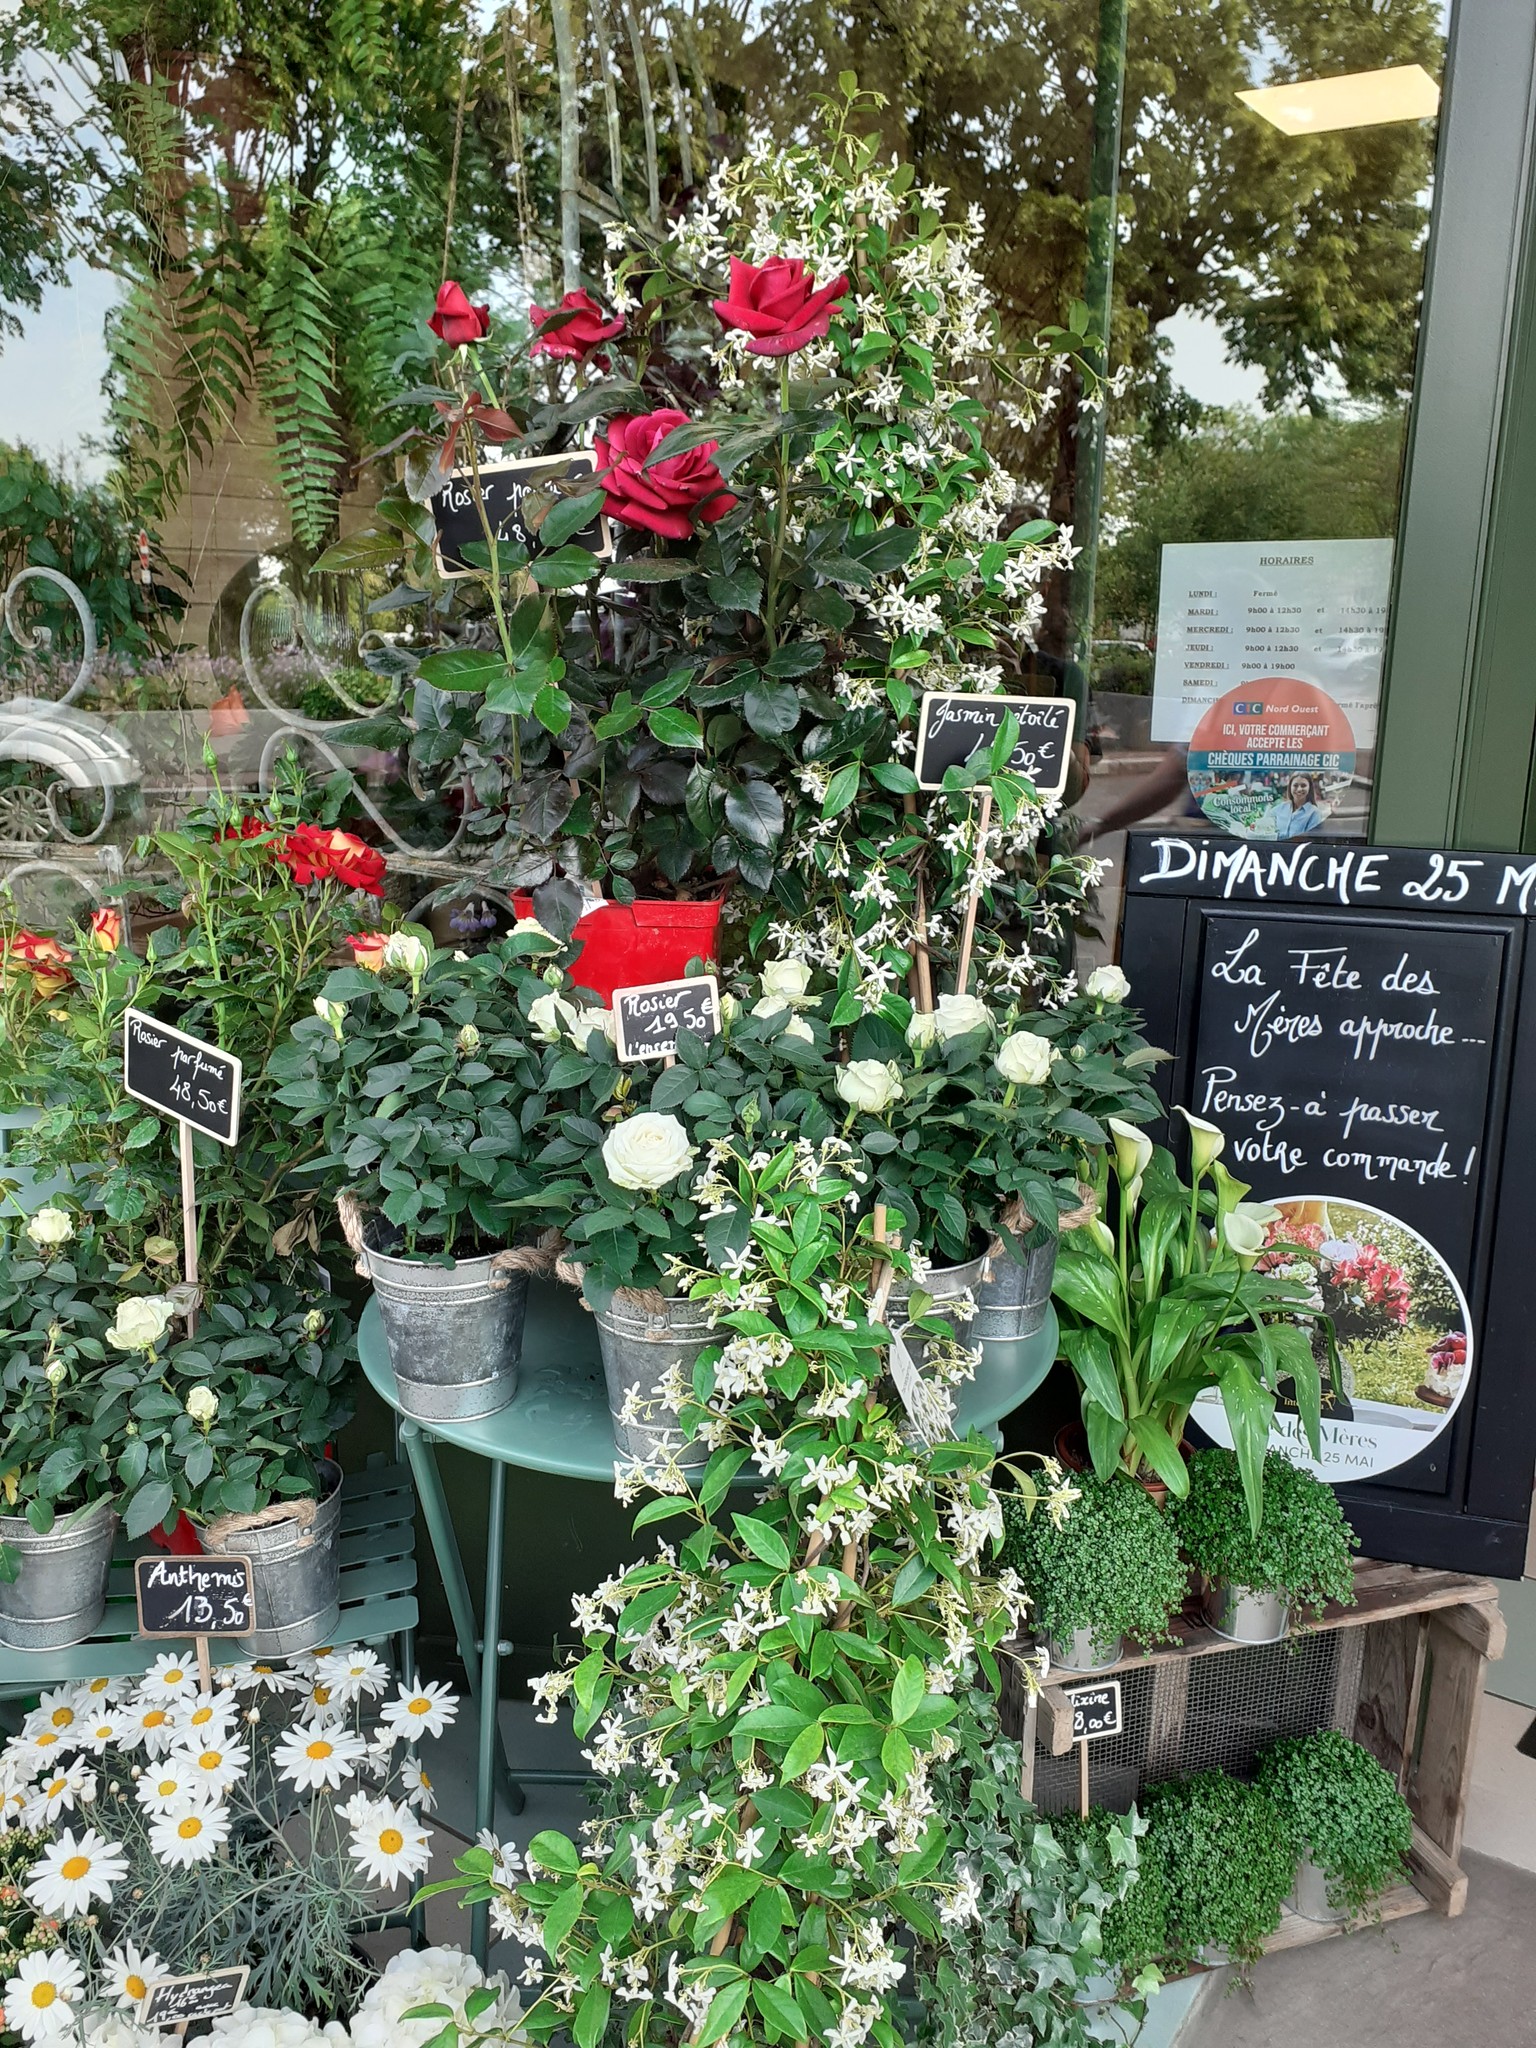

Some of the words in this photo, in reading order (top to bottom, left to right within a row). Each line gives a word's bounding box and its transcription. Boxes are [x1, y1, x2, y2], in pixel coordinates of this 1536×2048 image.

[442, 481, 494, 512] Roser
[1259, 556, 1314, 567] HORAIRES
[928, 699, 1000, 739] Jasmin
[1234, 702, 1263, 715] CIC
[1265, 704, 1289, 713] Nord
[1291, 705, 1319, 714] Ouest
[1222, 723, 1237, 736] ICI,
[1239, 724, 1267, 736] VOTRE
[1268, 724, 1330, 738] COMMERÇANT
[1246, 737, 1285, 749] ACCEPTE
[1286, 737, 1304, 749] LES
[1207, 751, 1254, 767] CHÈQUES
[1256, 754, 1320, 767] PARRAINAGE
[1322, 754, 1340, 767] CIC
[1213, 794, 1274, 808] Consommons
[1230, 803, 1251, 814] local
[1402, 853, 1485, 902] 25
[1211, 928, 1266, 986] La
[1287, 946, 1362, 990] Fête
[1381, 953, 1441, 995] des
[623, 990, 692, 1017] Rosier
[1234, 989, 1323, 1058] Mères
[130, 1019, 167, 1048] Rosier
[170, 1046, 226, 1080] parfumé
[169, 1074, 228, 1114] 48,50€
[1339, 1097, 1444, 1139] passer
[1234, 1131, 1307, 1174] votre
[1323, 1142, 1456, 1185] commande
[1320, 1425, 1377, 1449] Mères
[1324, 1452, 1340, 1463] 25
[1344, 1454, 1374, 1468] MAI
[147, 1561, 245, 1592] Anthemis
[155, 1983, 233, 2006] Hydrangea
